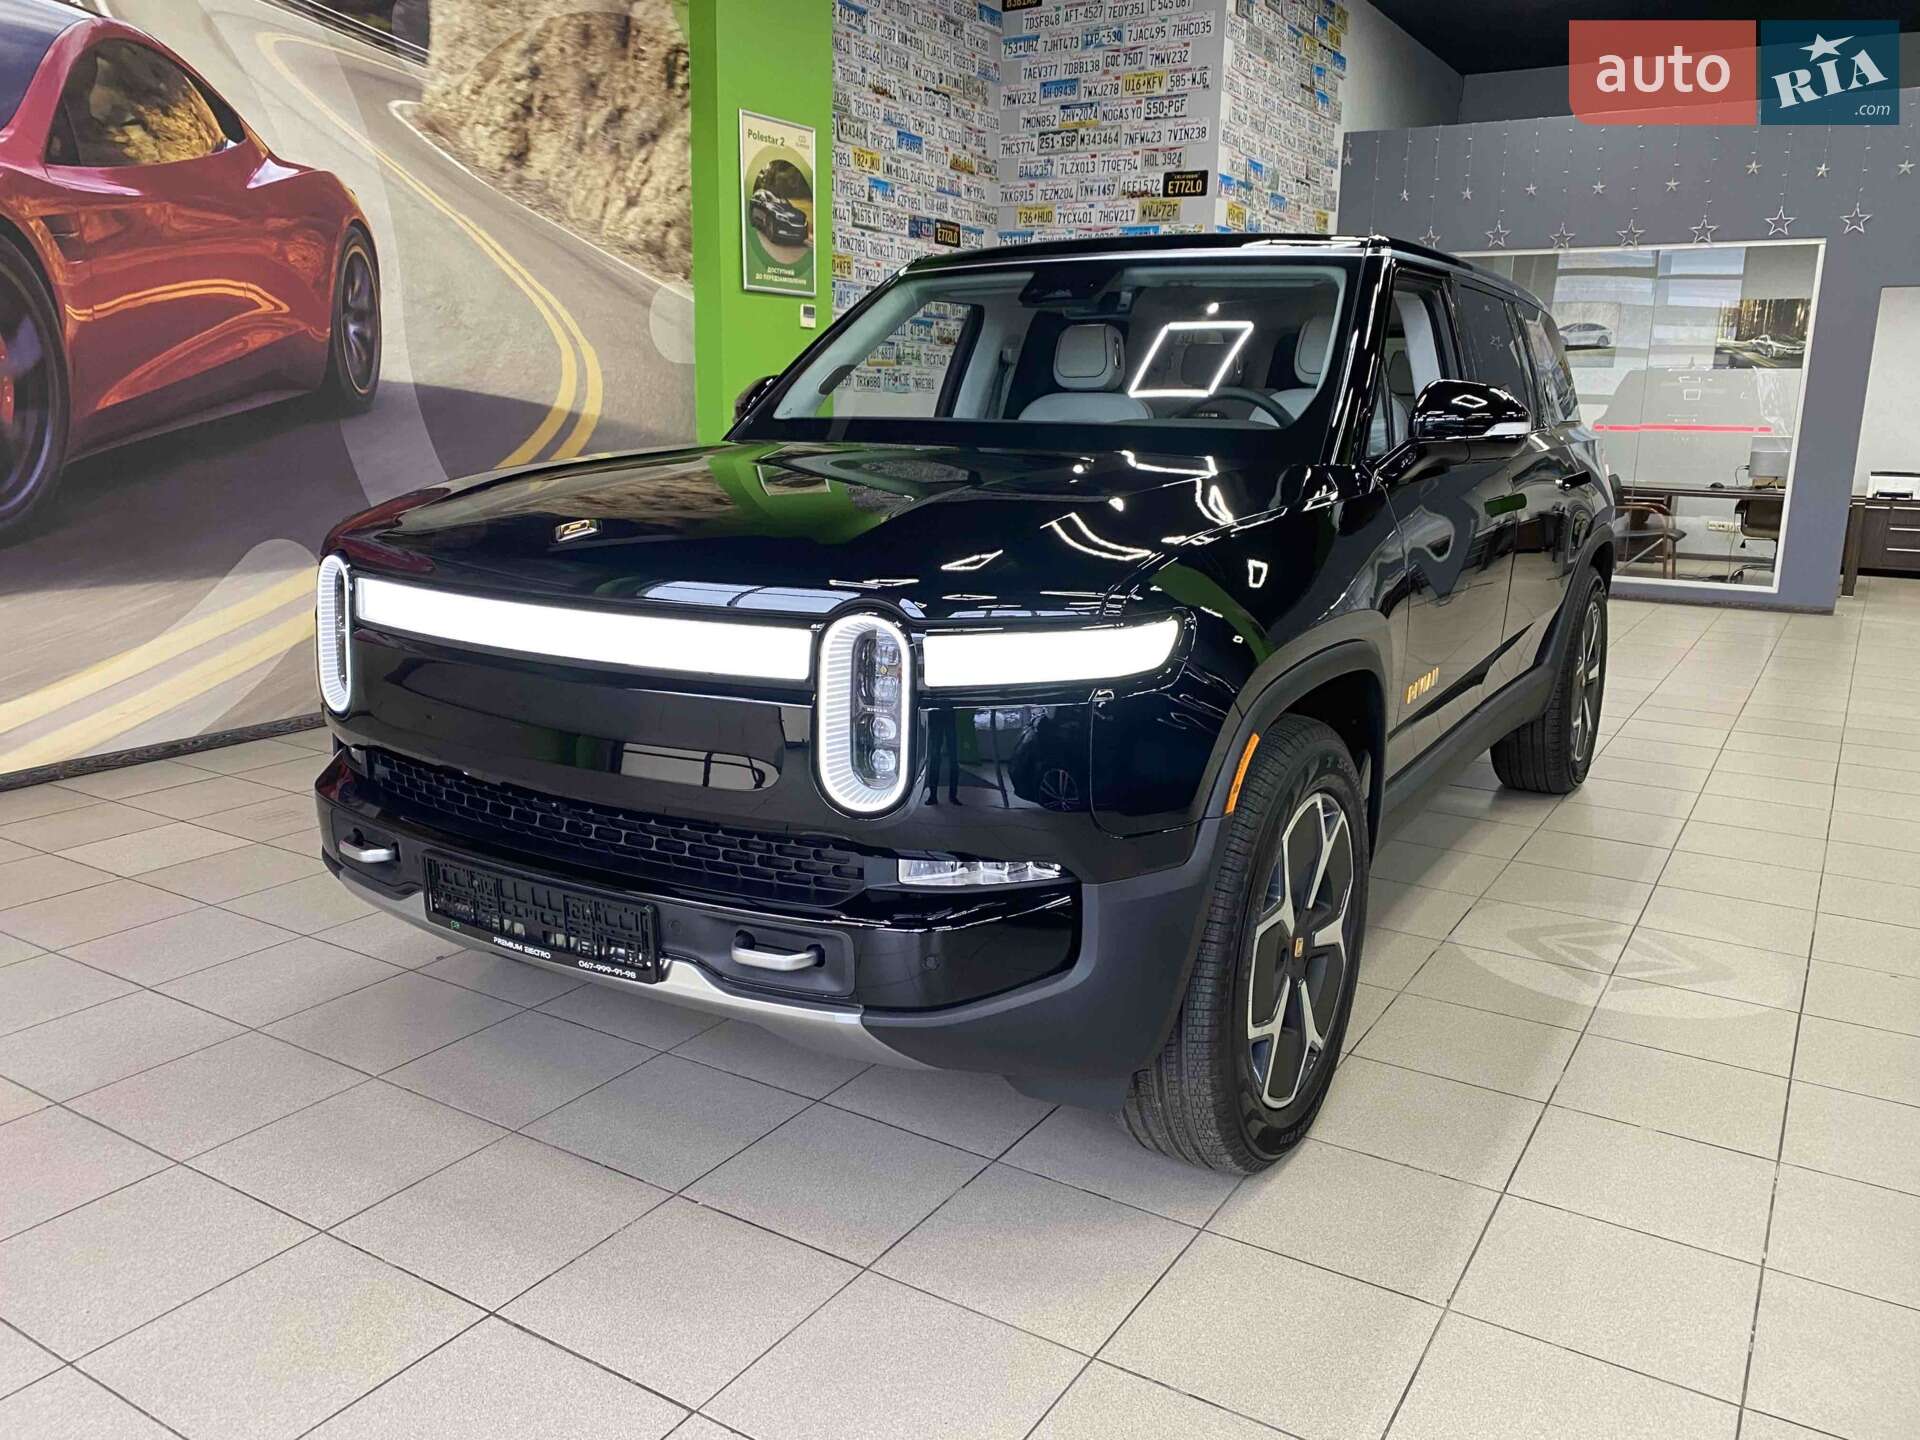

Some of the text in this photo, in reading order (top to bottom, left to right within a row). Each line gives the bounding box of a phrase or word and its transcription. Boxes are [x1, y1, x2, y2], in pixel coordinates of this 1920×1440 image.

[1024, 13, 1060, 29] 7DSF848
[1127, 25, 1166, 42] 7JAC495
[1043, 35, 1079, 51] 7JHT473
[1149, 49, 1189, 65] 7MWV232
[1023, 63, 1058, 79] 7AEV377
[1002, 90, 1037, 106] 7MWV232
[1083, 82, 1120, 98] 7WXJ278
[747, 128, 779, 145] Polestar
[780, 136, 785, 147] 2
[1124, 128, 1162, 145] 7NFW423
[1167, 123, 1207, 141] 7VIN238
[1001, 139, 1036, 155] 7HCS774
[1059, 159, 1096, 176] 7LZX013
[1057, 209, 1093, 226] 7YCX401
[1098, 207, 1136, 224] 7HGV217
